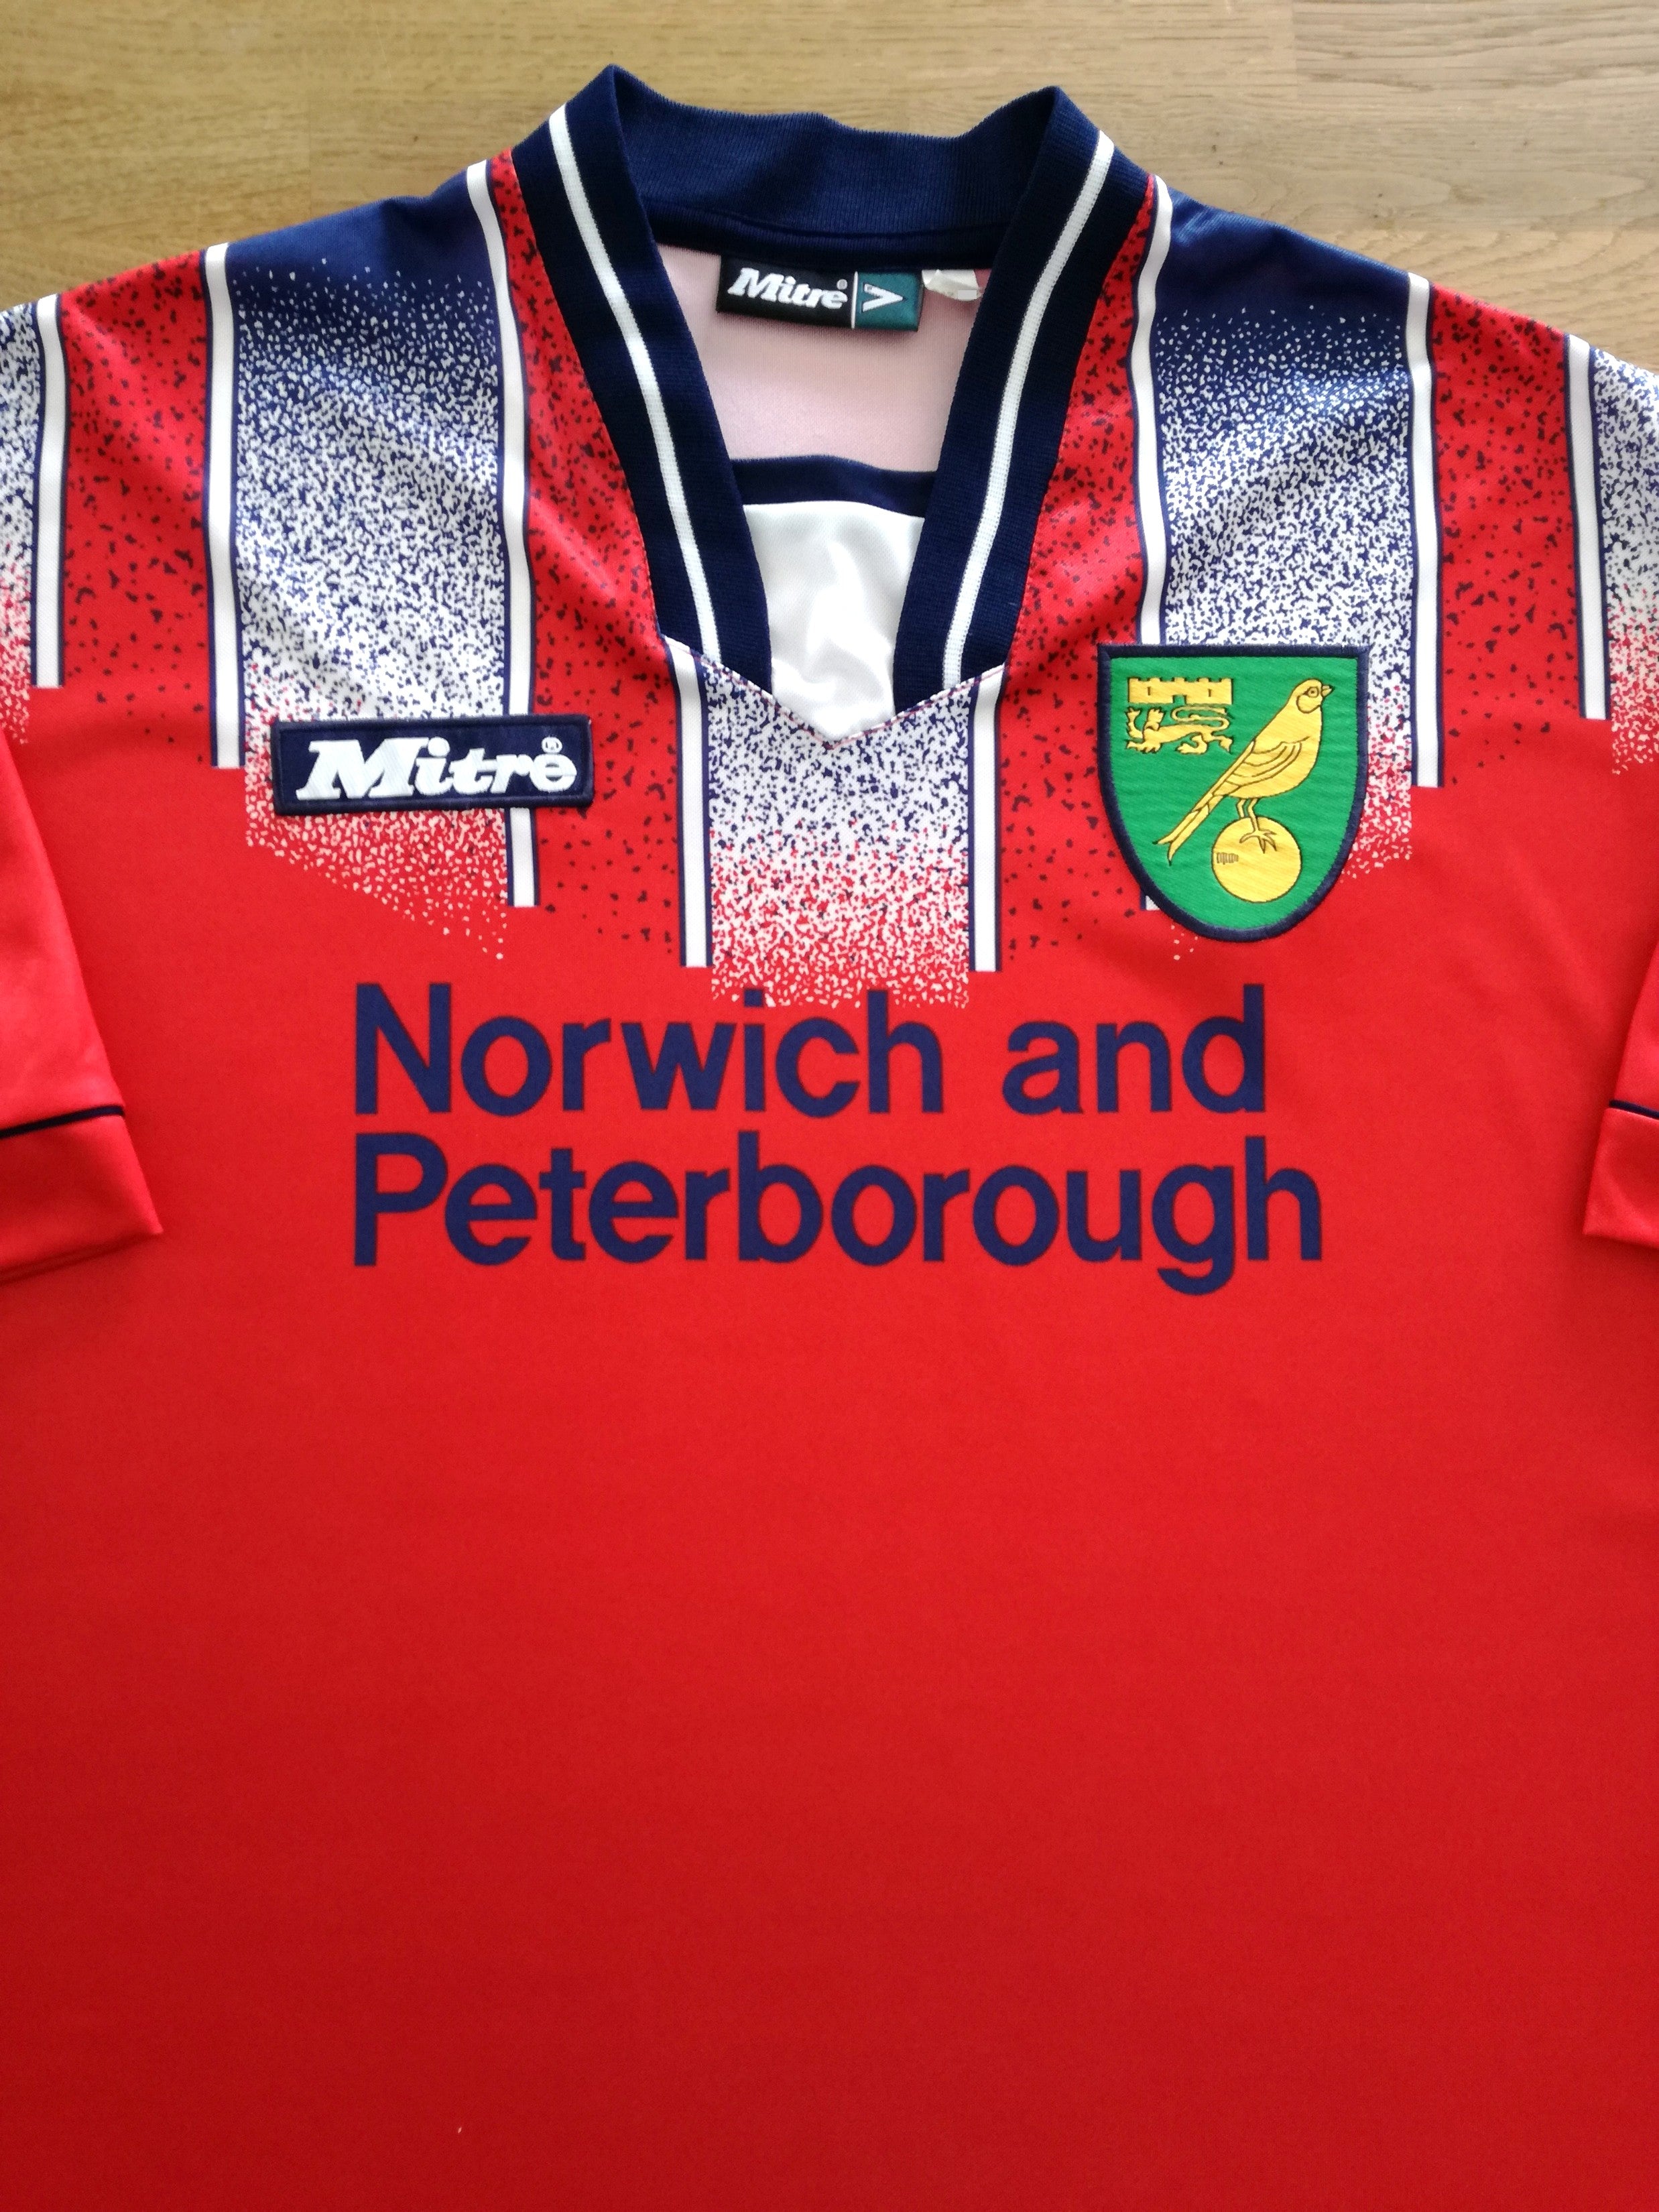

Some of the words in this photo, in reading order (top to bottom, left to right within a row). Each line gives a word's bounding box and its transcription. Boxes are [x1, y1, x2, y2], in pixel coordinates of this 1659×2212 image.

[355, 983, 944, 1118] Norwich
[1002, 983, 1266, 1115] and
[353, 1131, 1323, 1296] Peterborough
